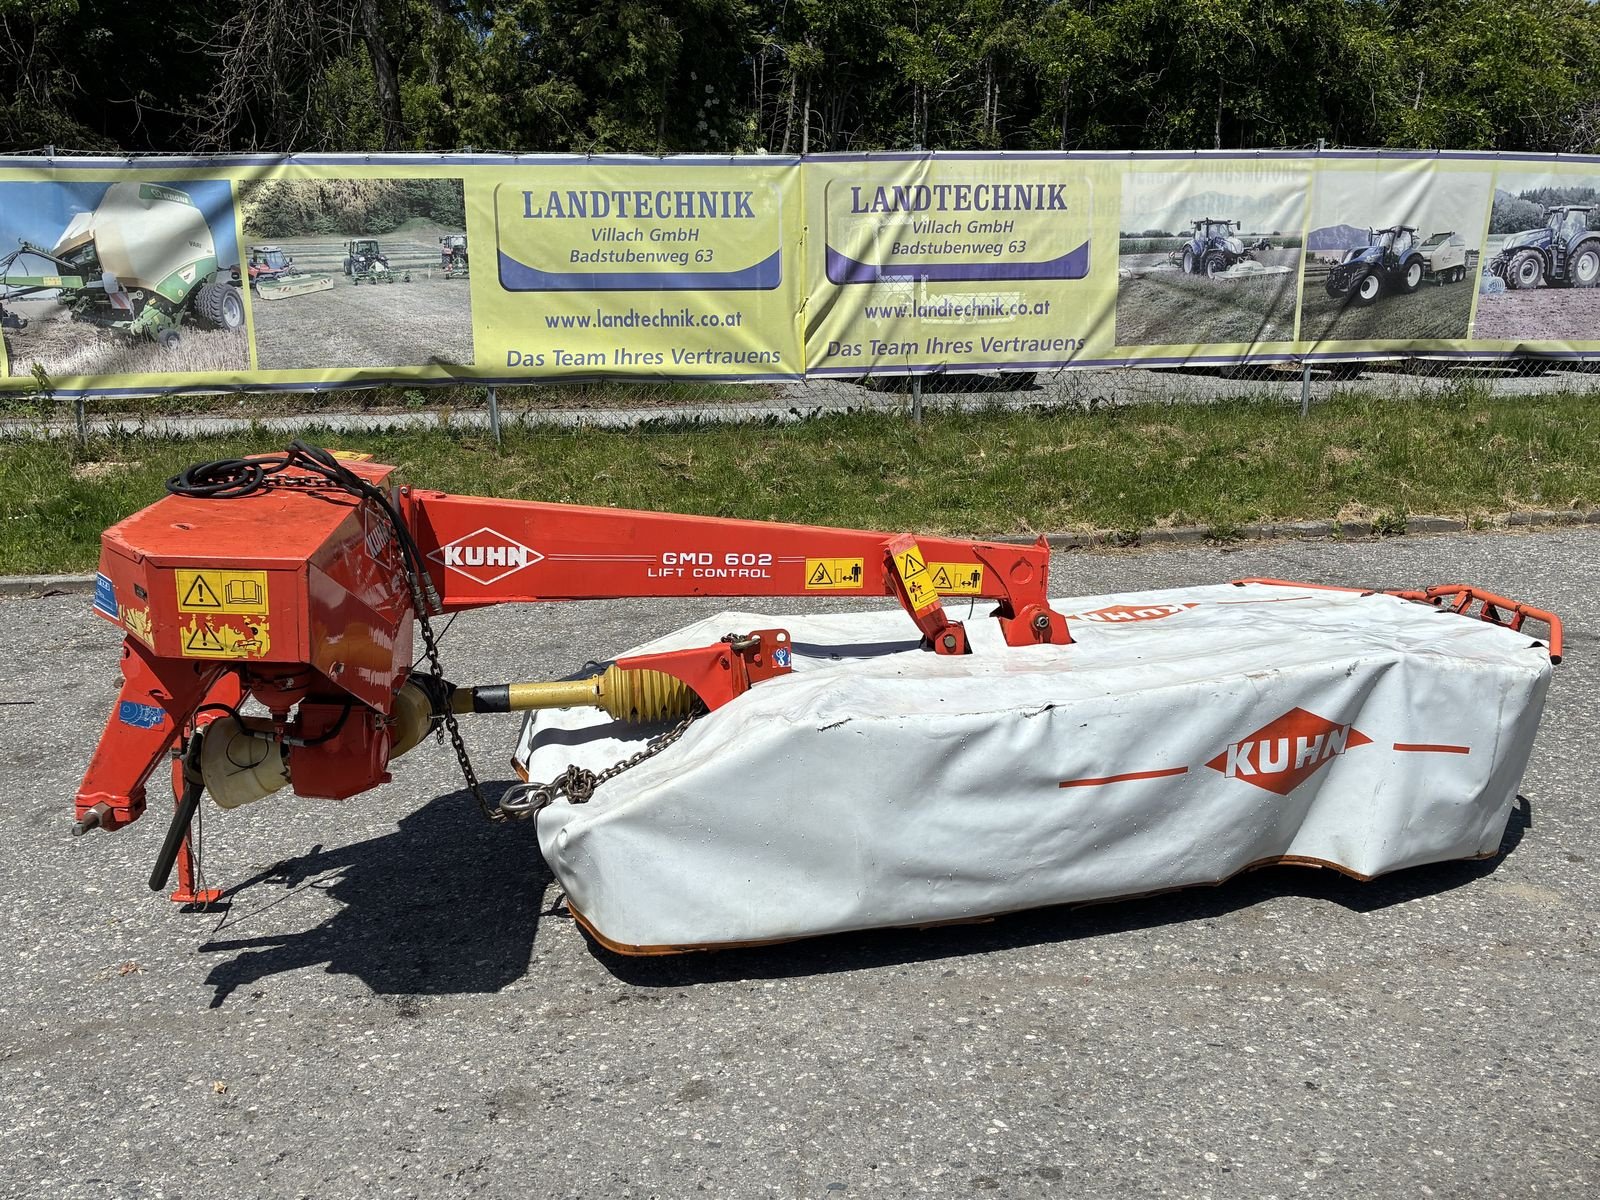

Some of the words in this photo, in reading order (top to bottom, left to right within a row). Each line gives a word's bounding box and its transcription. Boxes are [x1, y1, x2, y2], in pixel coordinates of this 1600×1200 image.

[522, 191, 755, 218] LANDTECHNIK
[851, 184, 1066, 212] LANDTECHNIK
[591, 228, 644, 242] Villach
[649, 228, 699, 242] GmbH
[912, 220, 961, 234] Villach
[967, 219, 1014, 234] GmbH
[570, 249, 689, 266] Badstubenweg
[695, 249, 713, 263] 63
[891, 241, 1002, 256] Badstubenweg
[1008, 240, 1026, 253] 63
[545, 308, 742, 328] www.landtechnik.co.at
[865, 299, 1050, 319] www.landtechnik.co.at
[506, 350, 545, 367] Das
[553, 349, 606, 367] Team
[614, 348, 663, 365] Ihres
[671, 347, 781, 364] Vertrauens
[827, 341, 862, 358] Das
[869, 339, 918, 356] Team
[926, 337, 974, 354] Ihres
[980, 336, 1086, 352] Vertrauens
[444, 546, 527, 567] KUHN
[662, 552, 714, 566] GMD
[725, 553, 773, 566] 602
[647, 568, 684, 578] LIFT
[692, 568, 771, 578] CONTROL
[1075, 604, 1190, 622] KUHN
[1225, 723, 1352, 778] KUHN
